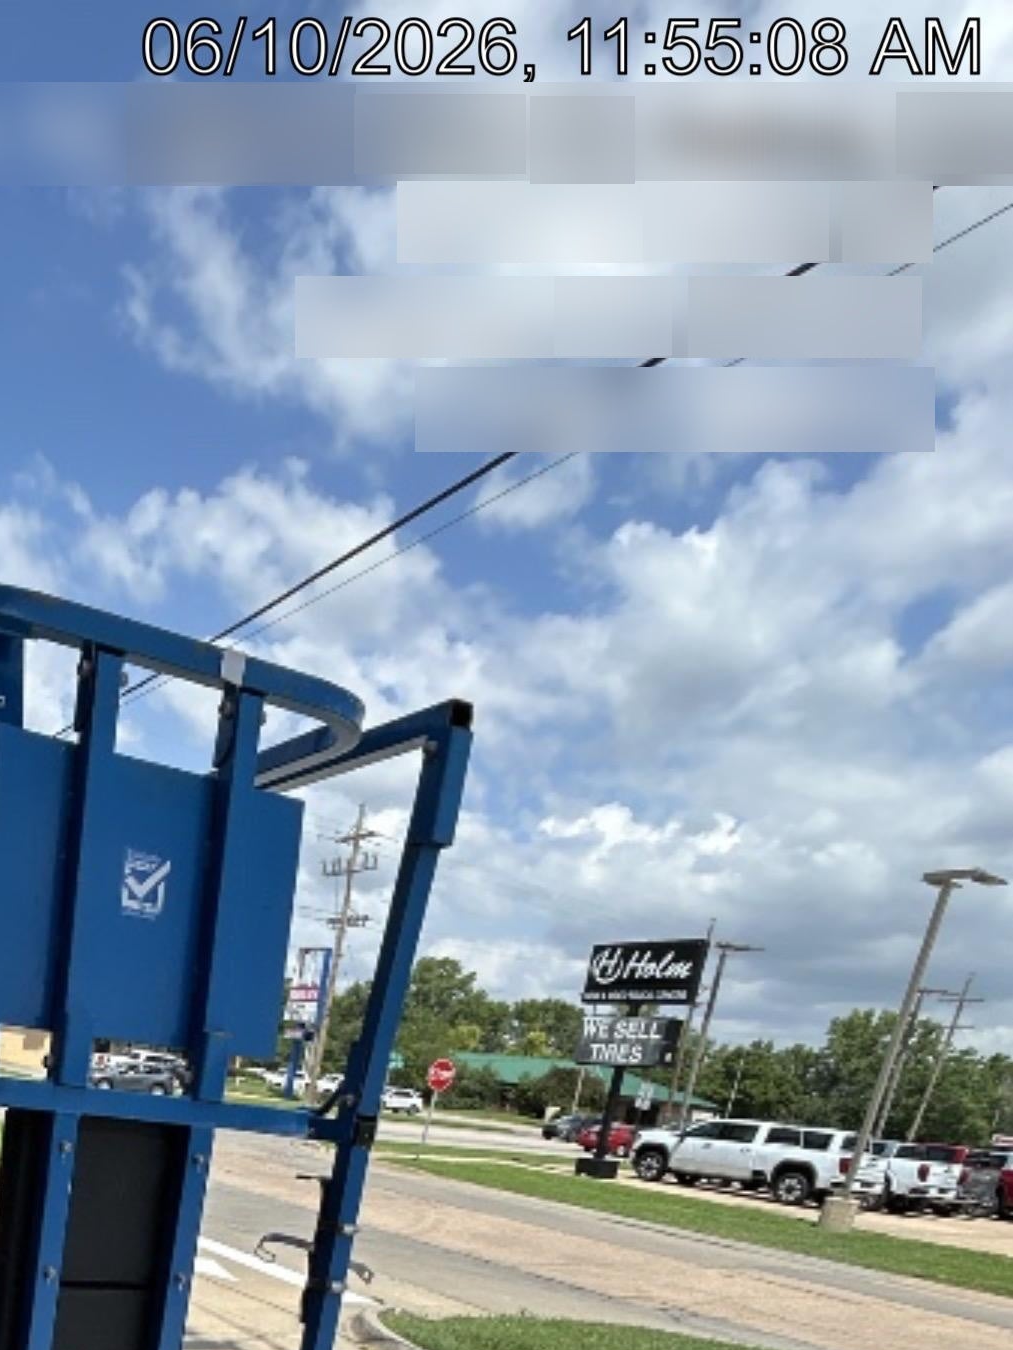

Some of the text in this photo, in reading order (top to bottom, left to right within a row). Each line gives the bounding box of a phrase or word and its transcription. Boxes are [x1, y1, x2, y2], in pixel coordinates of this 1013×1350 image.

[622, 950, 693, 979] Holm
[583, 1016, 662, 1039] WE SELL
